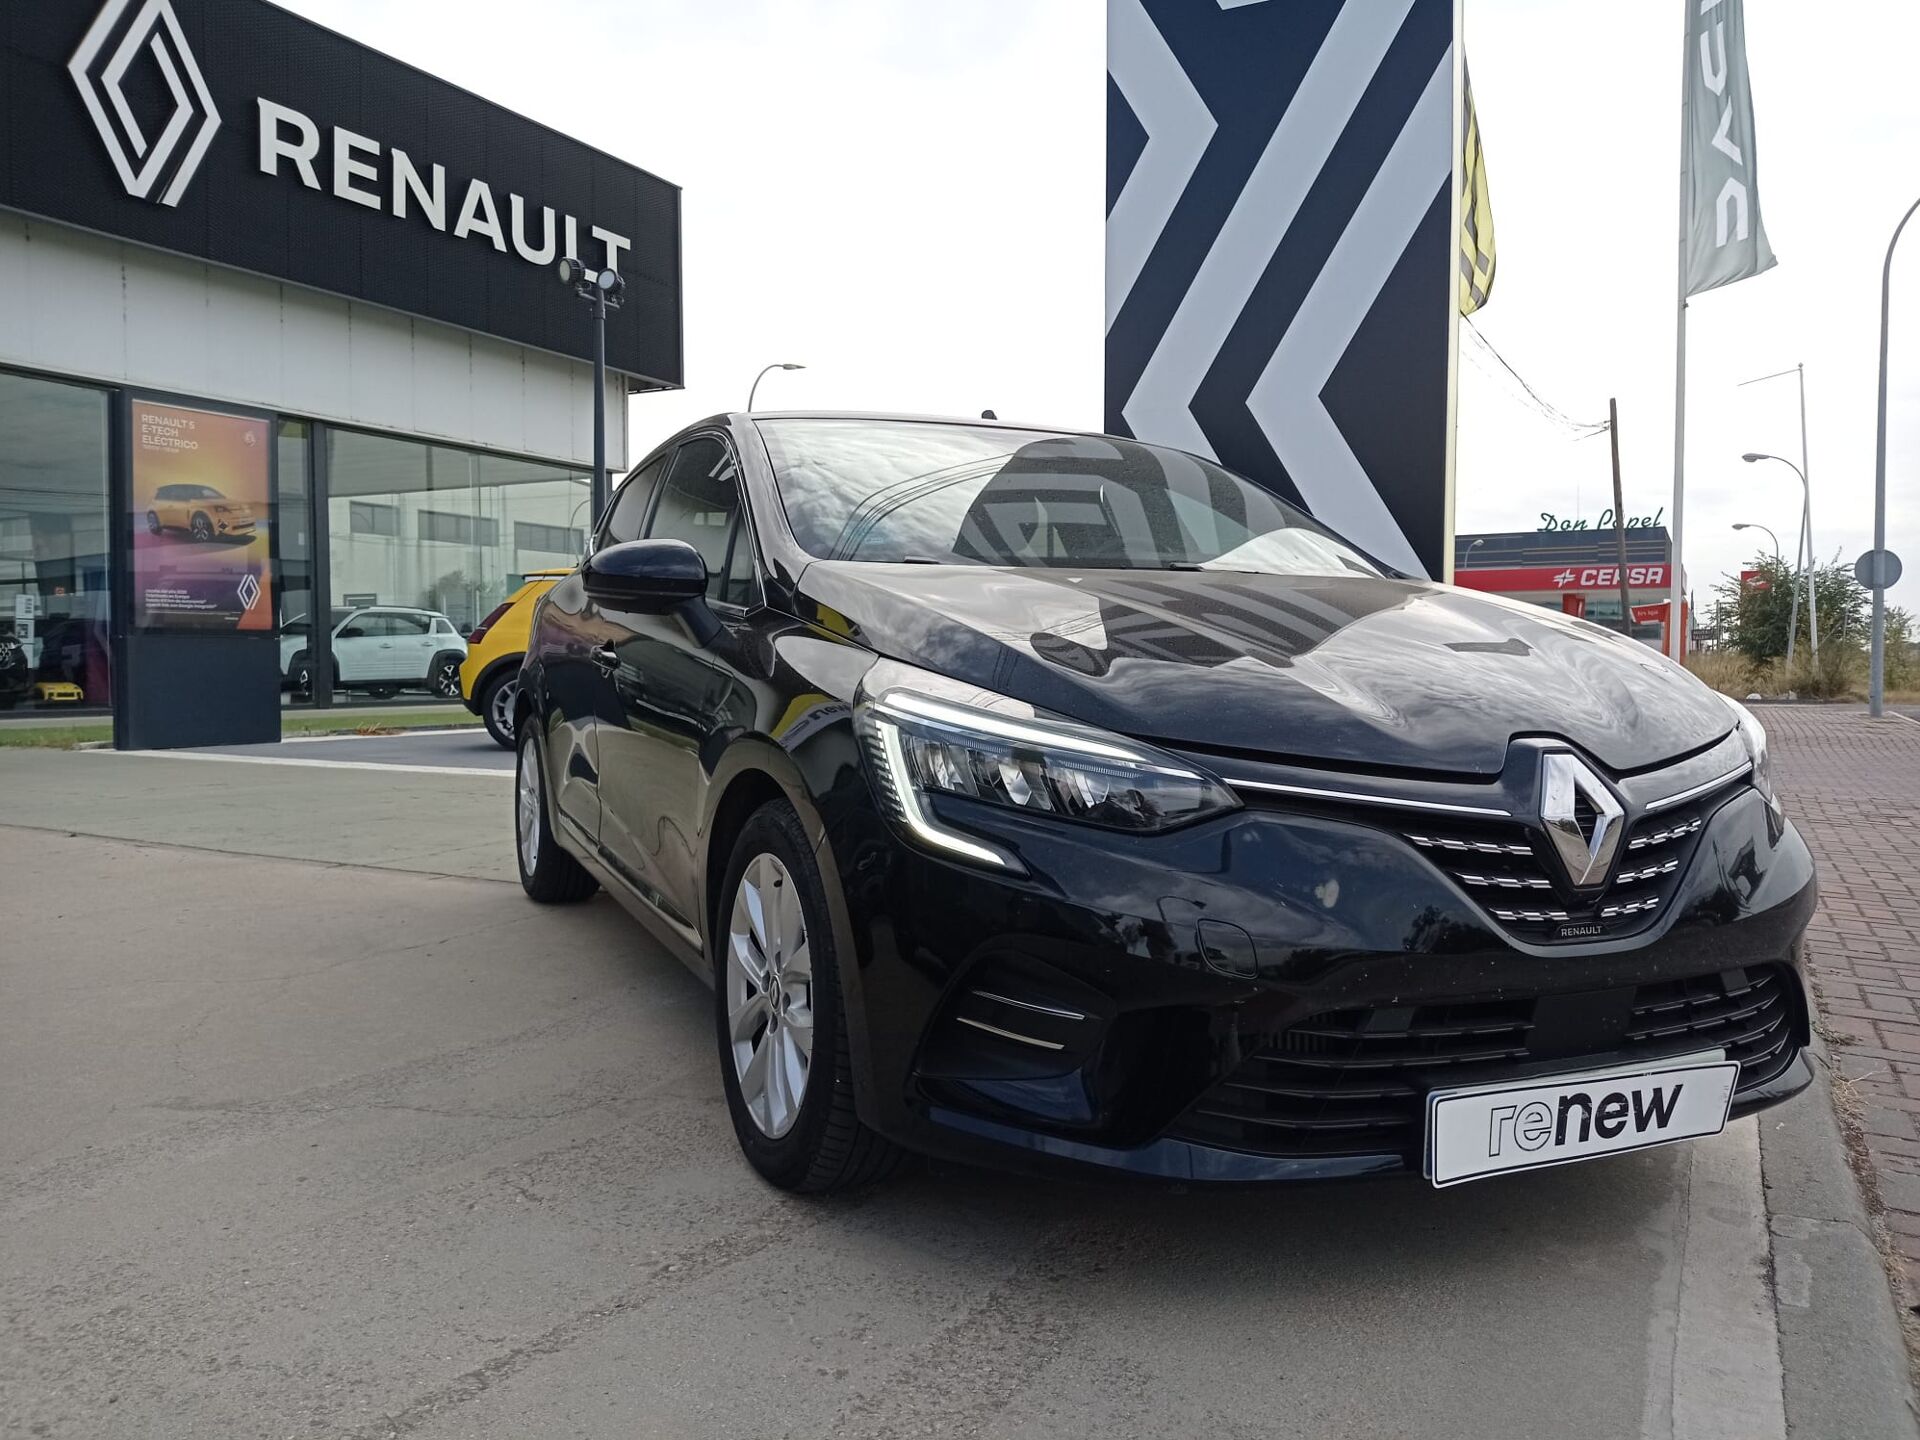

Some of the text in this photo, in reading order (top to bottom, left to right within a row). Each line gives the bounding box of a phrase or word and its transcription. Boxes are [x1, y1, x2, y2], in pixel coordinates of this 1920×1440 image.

[257, 97, 631, 284] RENAULT
[141, 414, 187, 428] RENAULT
[141, 425, 179, 437] E-TECH
[1561, 926, 1602, 937] RENAULT
[1489, 1084, 1683, 1157] renew
